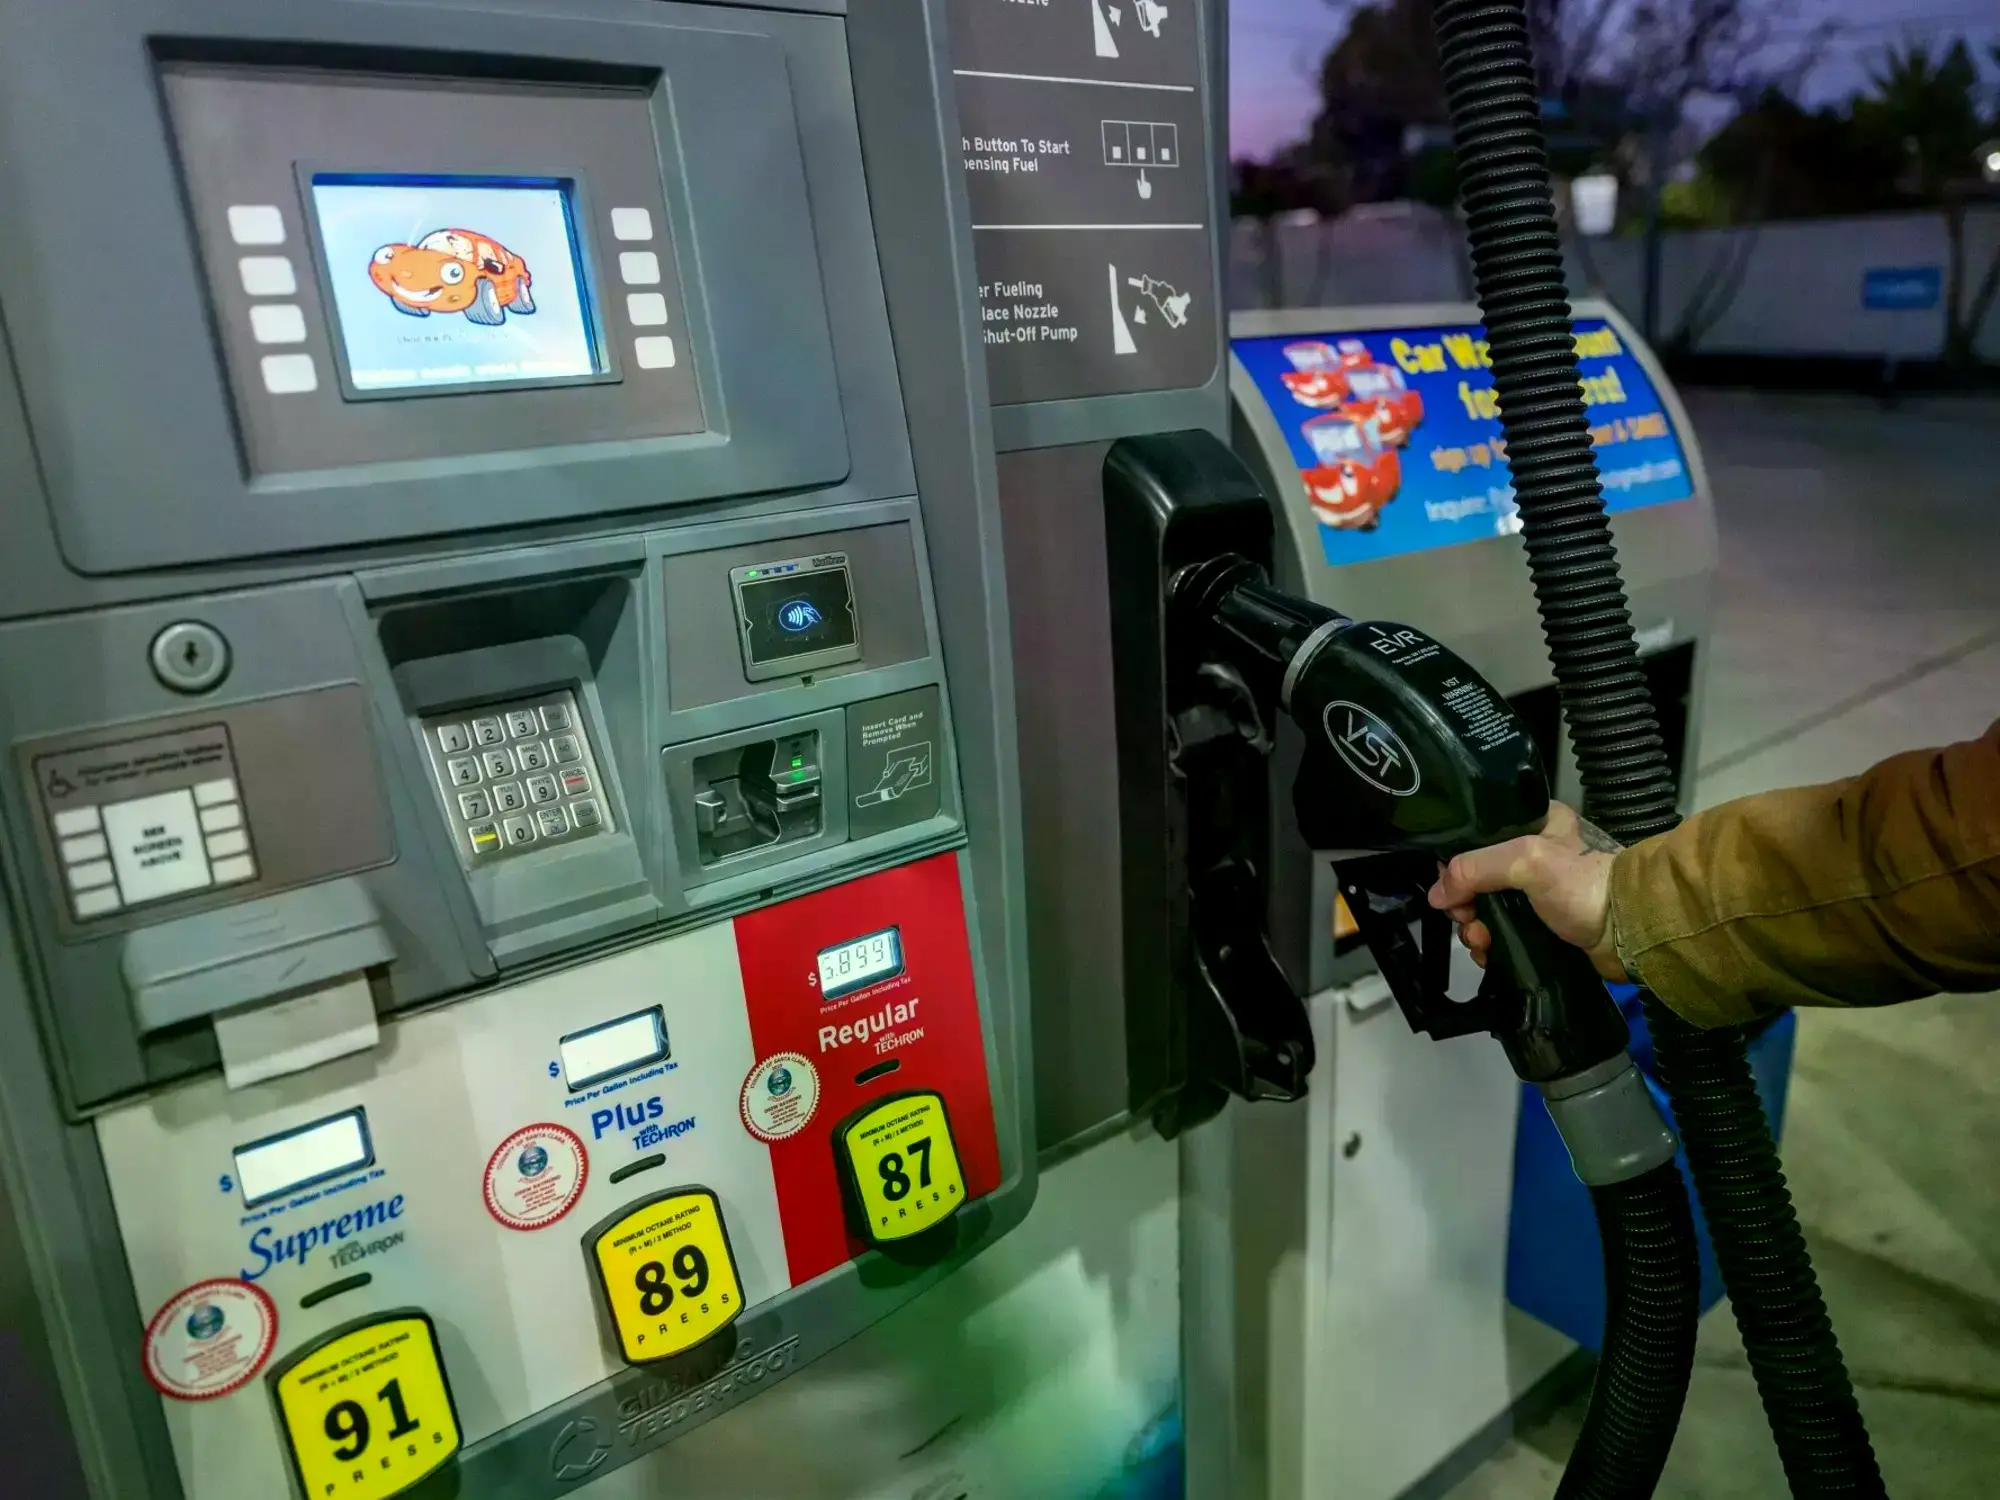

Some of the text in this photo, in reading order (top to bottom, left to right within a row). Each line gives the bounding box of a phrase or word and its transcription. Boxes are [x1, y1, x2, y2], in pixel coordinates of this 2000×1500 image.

[974, 137, 1018, 153] Button
[1020, 138, 1035, 153] To
[1039, 139, 1071, 155] Start
[1013, 156, 1038, 172] Fuel
[994, 281, 1043, 299] Fueling
[1014, 303, 1059, 319] Nozzle
[1041, 326, 1078, 342] Pump
[1390, 337, 1447, 375] Car
[1370, 630, 1424, 655] EVR
[1441, 676, 1460, 688] VST
[518, 722, 527, 733] 3
[862, 711, 924, 732] Insert Card and
[863, 721, 917, 739] Remove When
[451, 736, 457, 747] 1
[484, 728, 494, 740] 2
[863, 731, 901, 746] Prompted
[1338, 710, 1401, 778] VST
[495, 762, 504, 773] 5
[529, 754, 538, 766] 6
[461, 769, 469, 780] 4
[562, 767, 585, 777] CANCEL
[505, 795, 514, 806] 8
[539, 787, 548, 798] 9
[470, 803, 478, 815] 7
[540, 808, 562, 819] ENTER
[516, 828, 524, 840] 0
[808, 971, 818, 987] $
[820, 975, 911, 1014] Price Per Gallon Including Tax
[818, 997, 919, 1053] Regular
[874, 1026, 925, 1056] TECHRON
[879, 1031, 896, 1042] with
[548, 1061, 560, 1079] $
[564, 1061, 678, 1108] Price Per Gallon Including Tax
[591, 1096, 664, 1140] Plus
[860, 1104, 931, 1140] MINIMUM OCTANE RATING
[900, 1119, 924, 1133] METHOD
[632, 1116, 696, 1151] TECHRON
[639, 1123, 659, 1136] with
[878, 1135, 932, 1202] 87
[219, 1174, 233, 1193] $
[240, 1168, 385, 1227] Price Per Gallon Including Tax
[612, 1205, 701, 1248] MINIMUM OCTANE RATING
[663, 1222, 692, 1239] METHOD
[240, 1194, 405, 1281] Supreme
[328, 1230, 405, 1269] TECHRON
[635, 1244, 710, 1317] 89
[324, 1377, 421, 1462] 91
